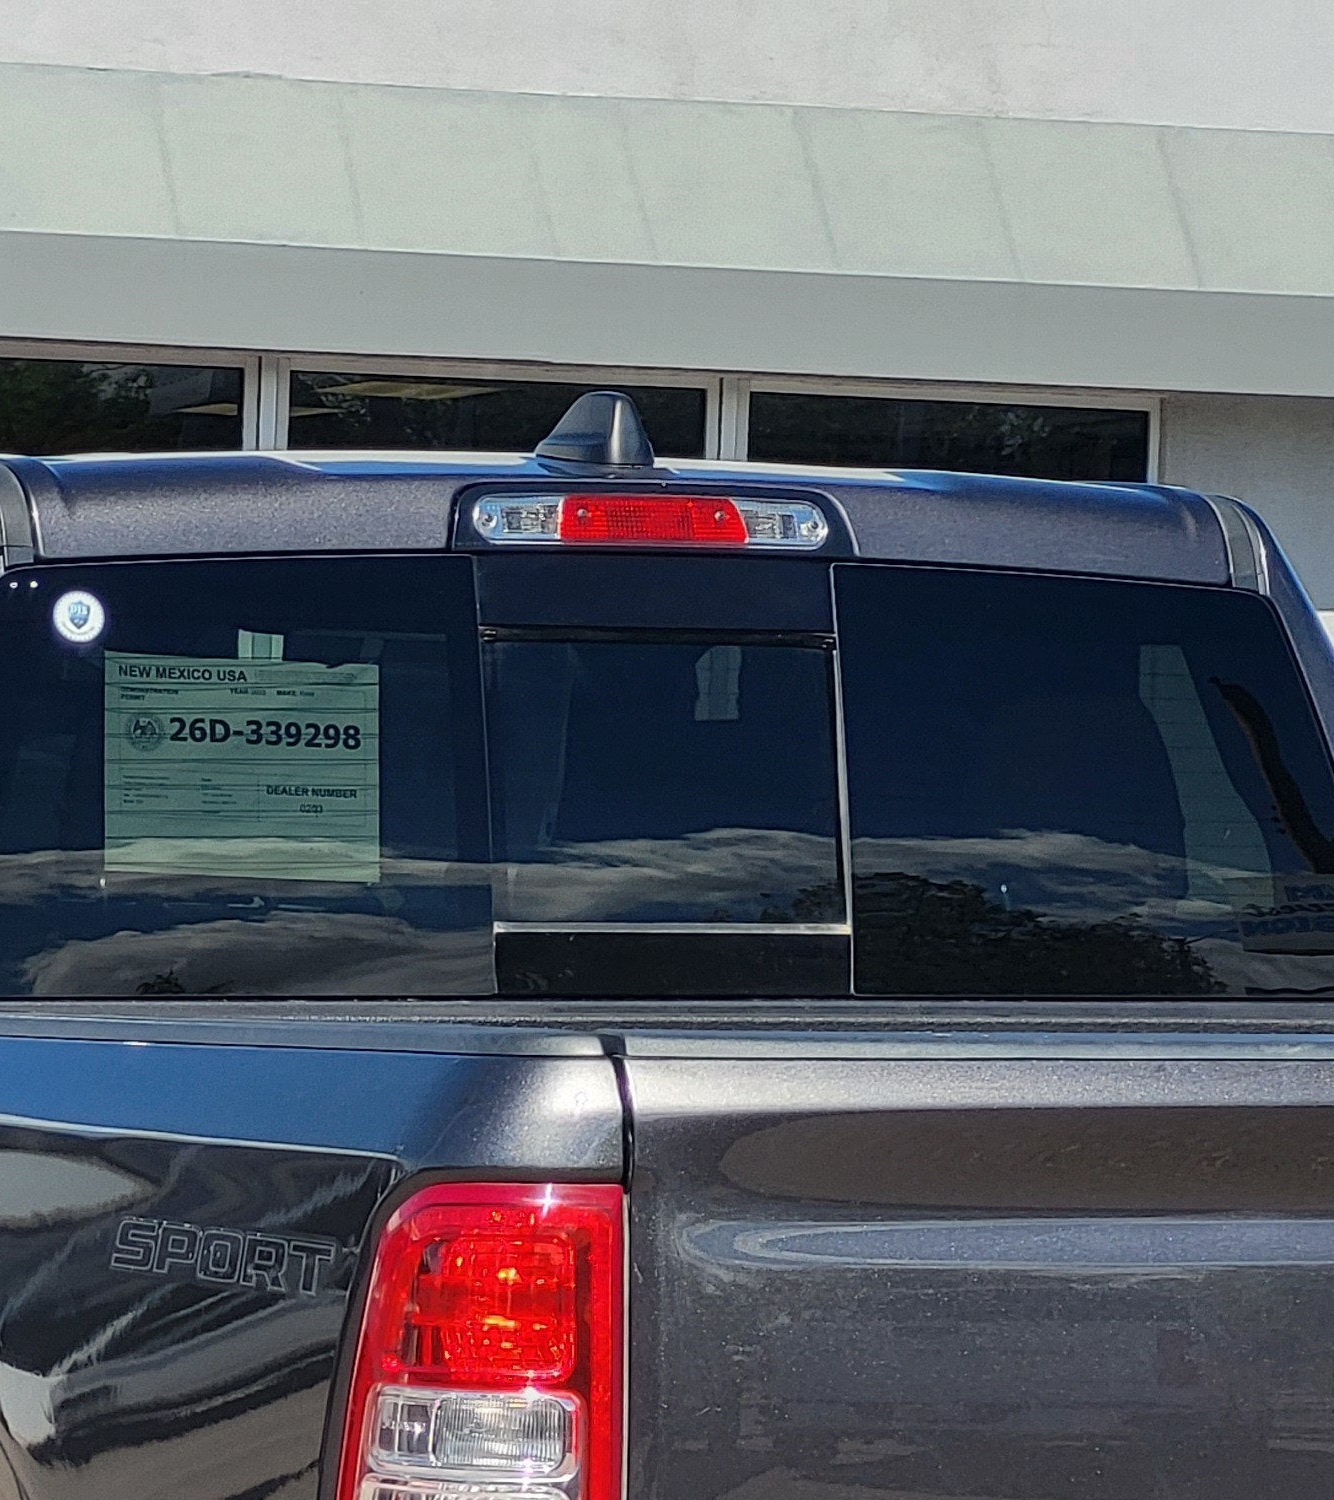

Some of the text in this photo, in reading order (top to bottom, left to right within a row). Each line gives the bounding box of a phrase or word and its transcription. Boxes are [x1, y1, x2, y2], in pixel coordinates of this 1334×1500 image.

[118, 665, 152, 679] NEW
[155, 666, 212, 681] MEXICO
[217, 669, 247, 682] USA
[169, 716, 362, 750] 26D-339298
[266, 785, 358, 799] DEALER NUMBER
[110, 1216, 337, 1297] SPORT
